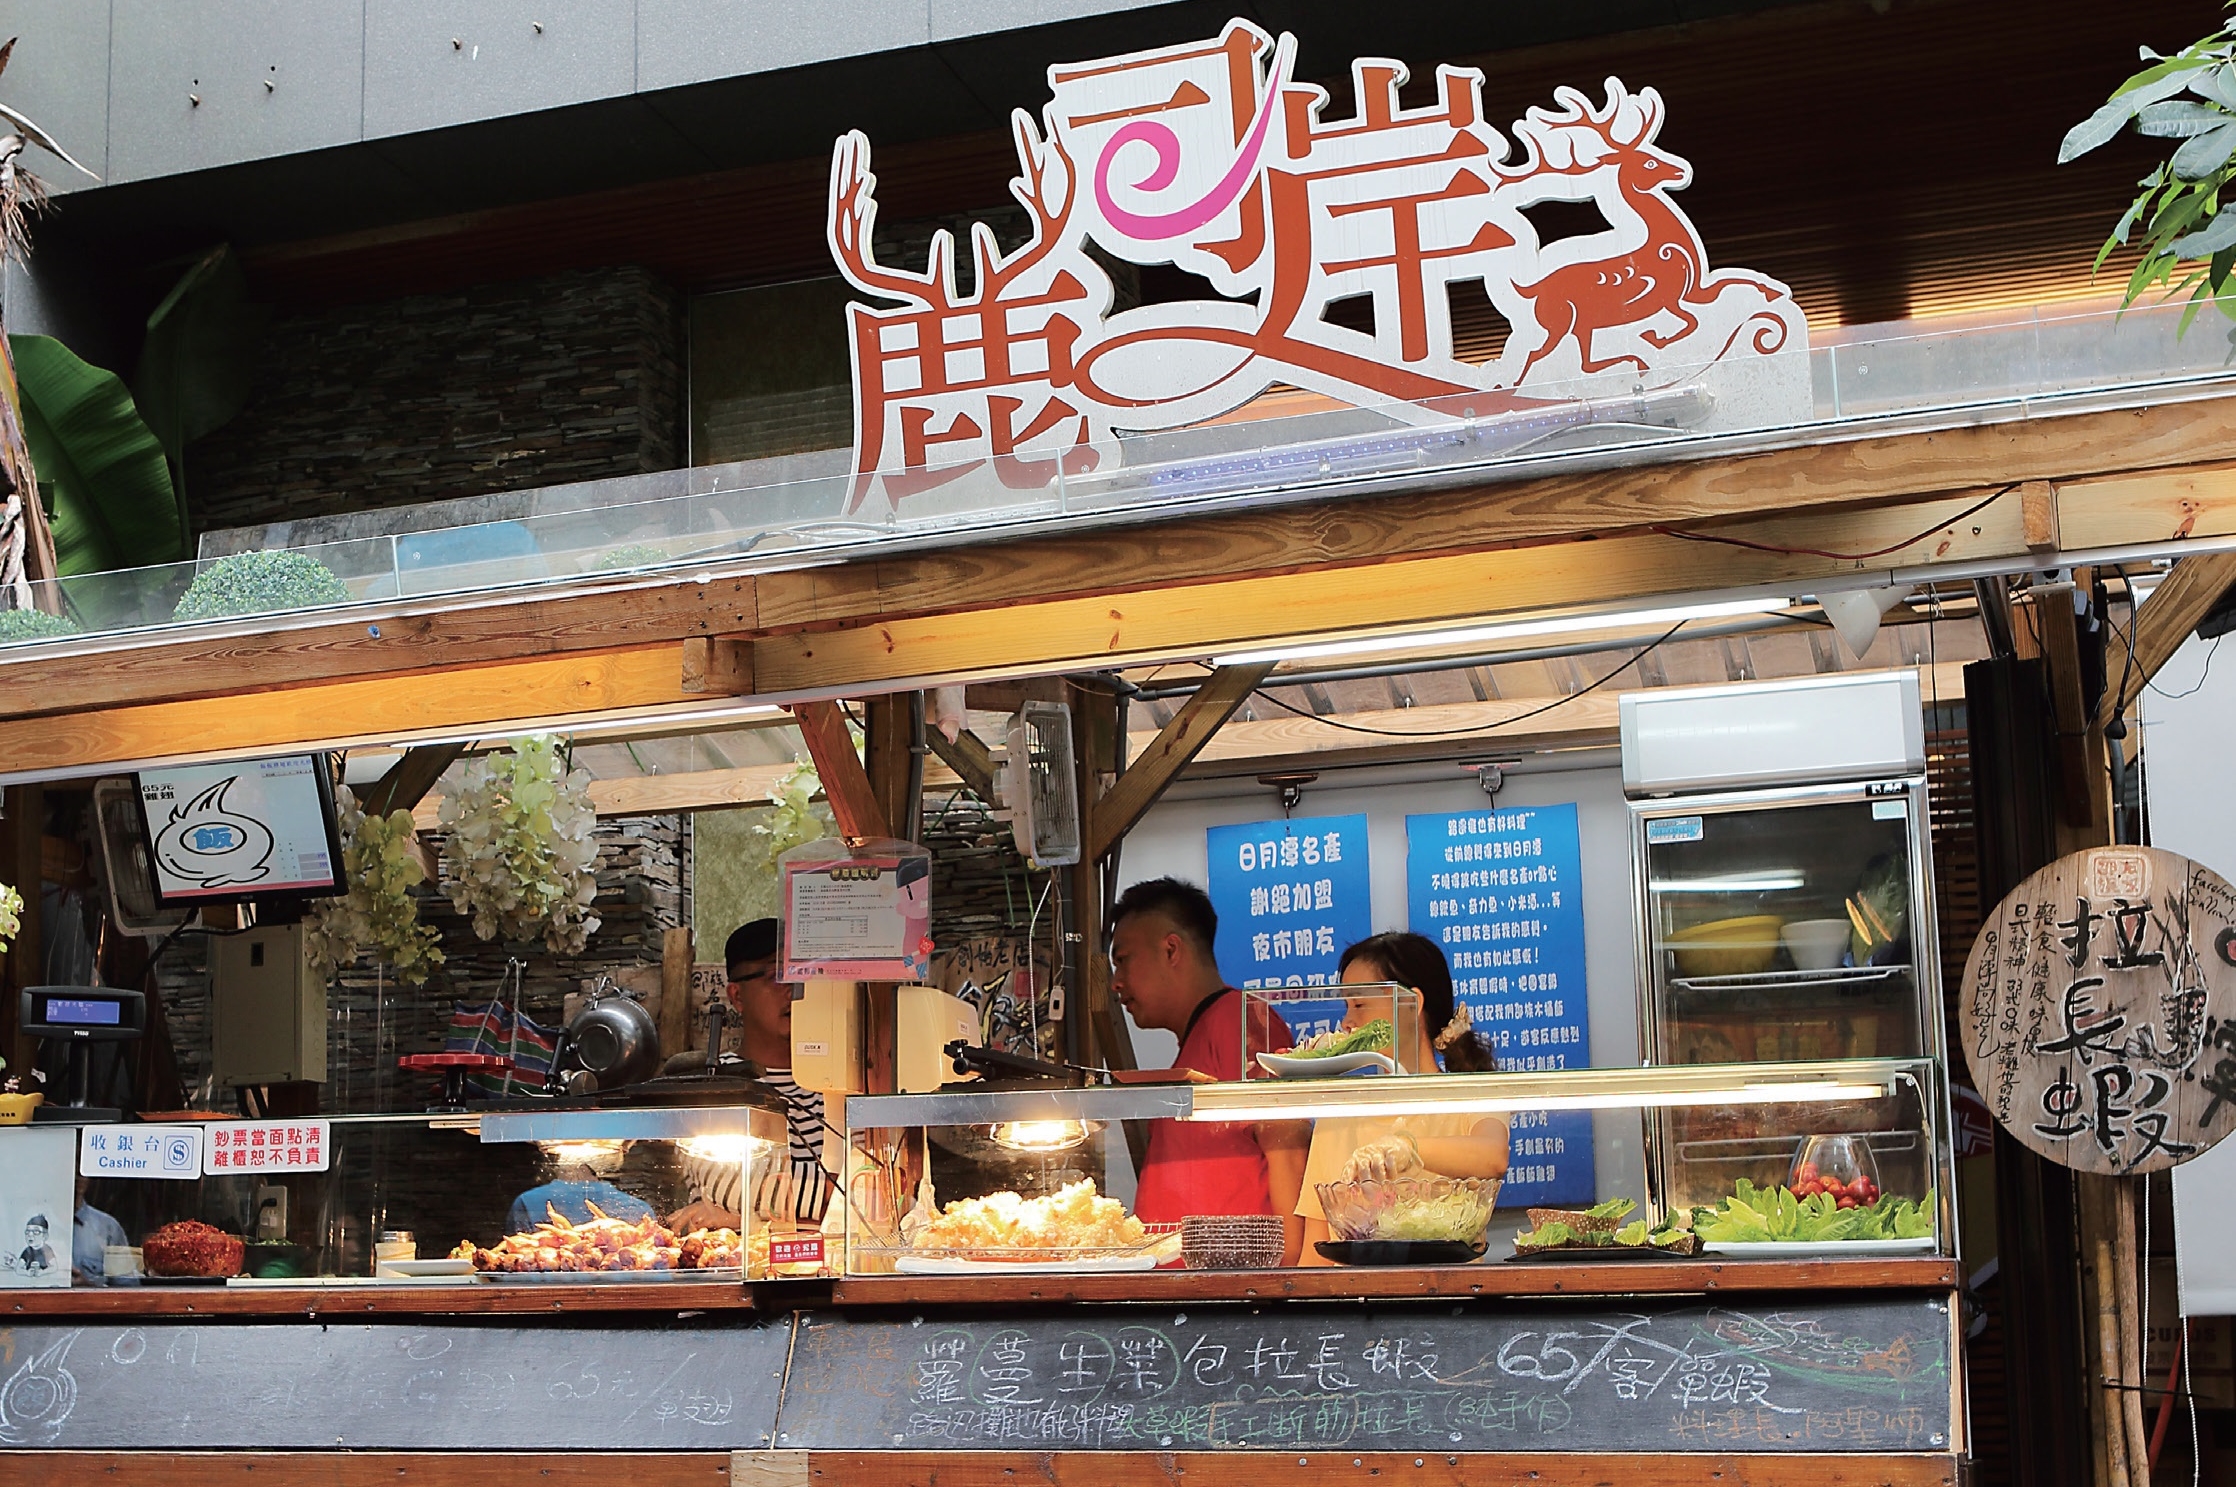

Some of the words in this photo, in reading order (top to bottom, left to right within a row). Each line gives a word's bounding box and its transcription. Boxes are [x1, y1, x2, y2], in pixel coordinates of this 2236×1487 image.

[142, 783, 175, 792] 65元
[193, 826, 234, 850] 飯
[1239, 832, 1342, 872] 日月潭名產
[1250, 879, 1333, 917] 謝絕加盟
[1252, 925, 1335, 962] 夜市朋友
[2033, 896, 2197, 1173] 拉長蝦
[91, 1135, 160, 1152] 收銀台
[214, 1127, 321, 1148] 鈔票當面點清
[98, 1156, 148, 1169] Cashier
[214, 1147, 321, 1168] 離櫃恕不負責
